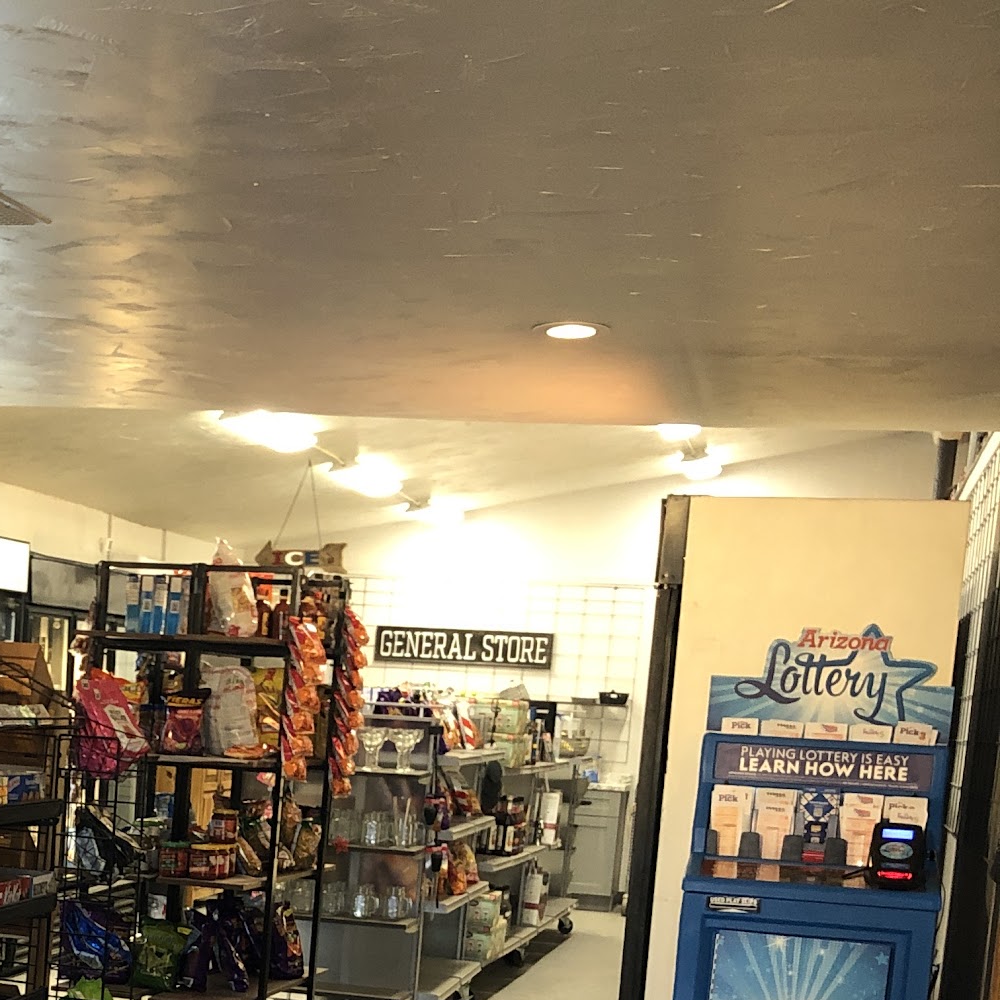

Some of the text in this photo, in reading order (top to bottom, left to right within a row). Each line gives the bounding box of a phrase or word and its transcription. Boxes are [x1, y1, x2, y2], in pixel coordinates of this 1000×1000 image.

[272, 550, 320, 566] ICE
[379, 630, 549, 664] GENERAL STORE
[797, 629, 891, 652] Arizona
[734, 641, 890, 725] Lottery
[899, 727, 919, 736] Pick
[741, 745, 909, 766] PLAYING LOTTERY IS EASY
[739, 757, 800, 775] LEARN
[804, 761, 855, 778] HOW
[859, 764, 908, 782] HERE
